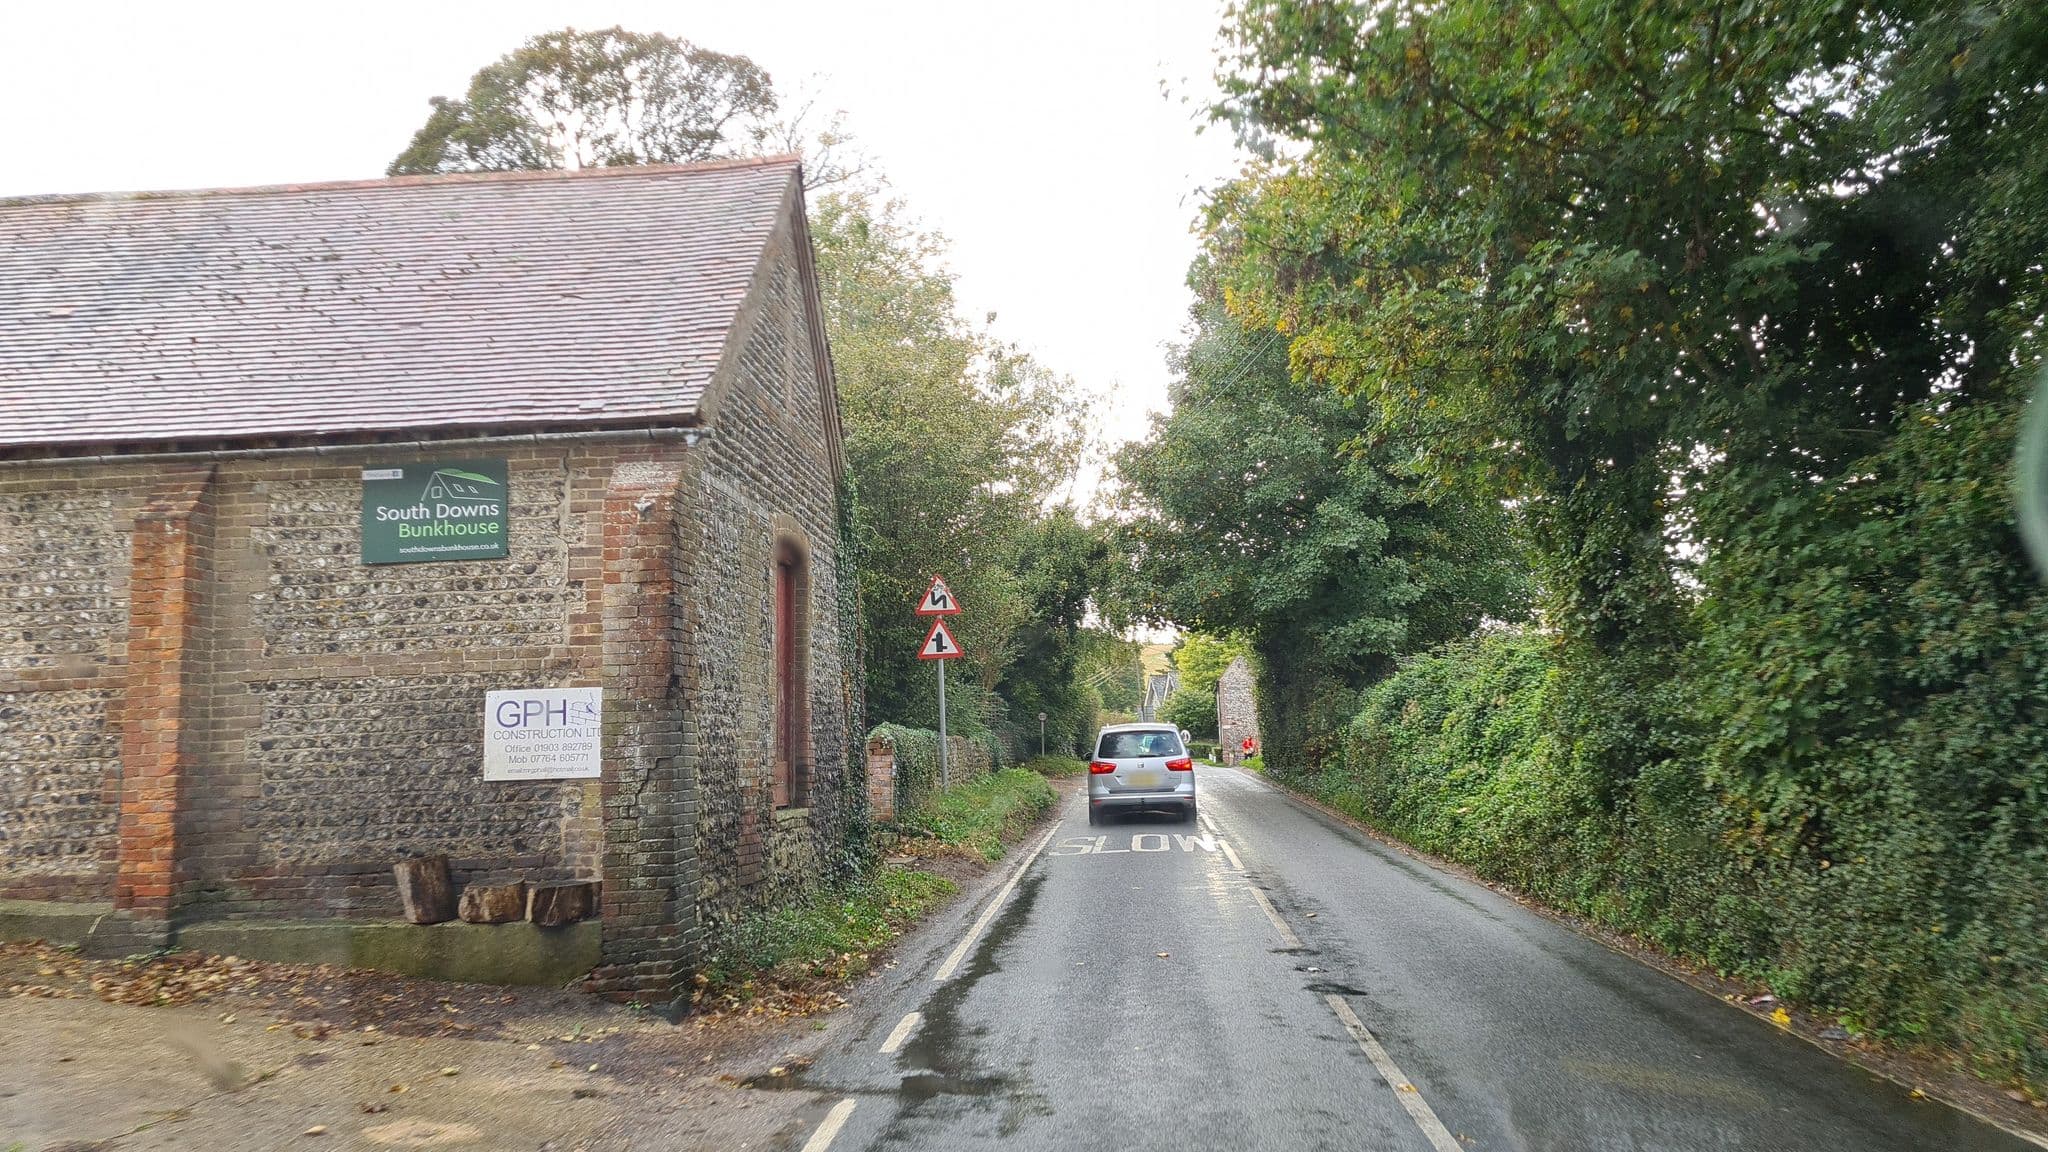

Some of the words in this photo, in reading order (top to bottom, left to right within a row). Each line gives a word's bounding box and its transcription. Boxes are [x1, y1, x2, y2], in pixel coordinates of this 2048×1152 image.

[376, 503, 430, 521] South
[436, 503, 499, 518] Downs
[399, 520, 499, 538] Bunkhouse
[399, 543, 499, 554] southdownsbunkhouse.co.uk
[496, 699, 566, 728] GPH
[493, 728, 581, 740] CONSTRUCTION
[504, 744, 531, 753] Office
[534, 743, 559, 752] 01903
[562, 742, 593, 751] 892789
[508, 755, 528, 764] Mob
[530, 754, 557, 763] 07764
[559, 753, 589, 762] 605771
[1049, 834, 1217, 855] SLOW
